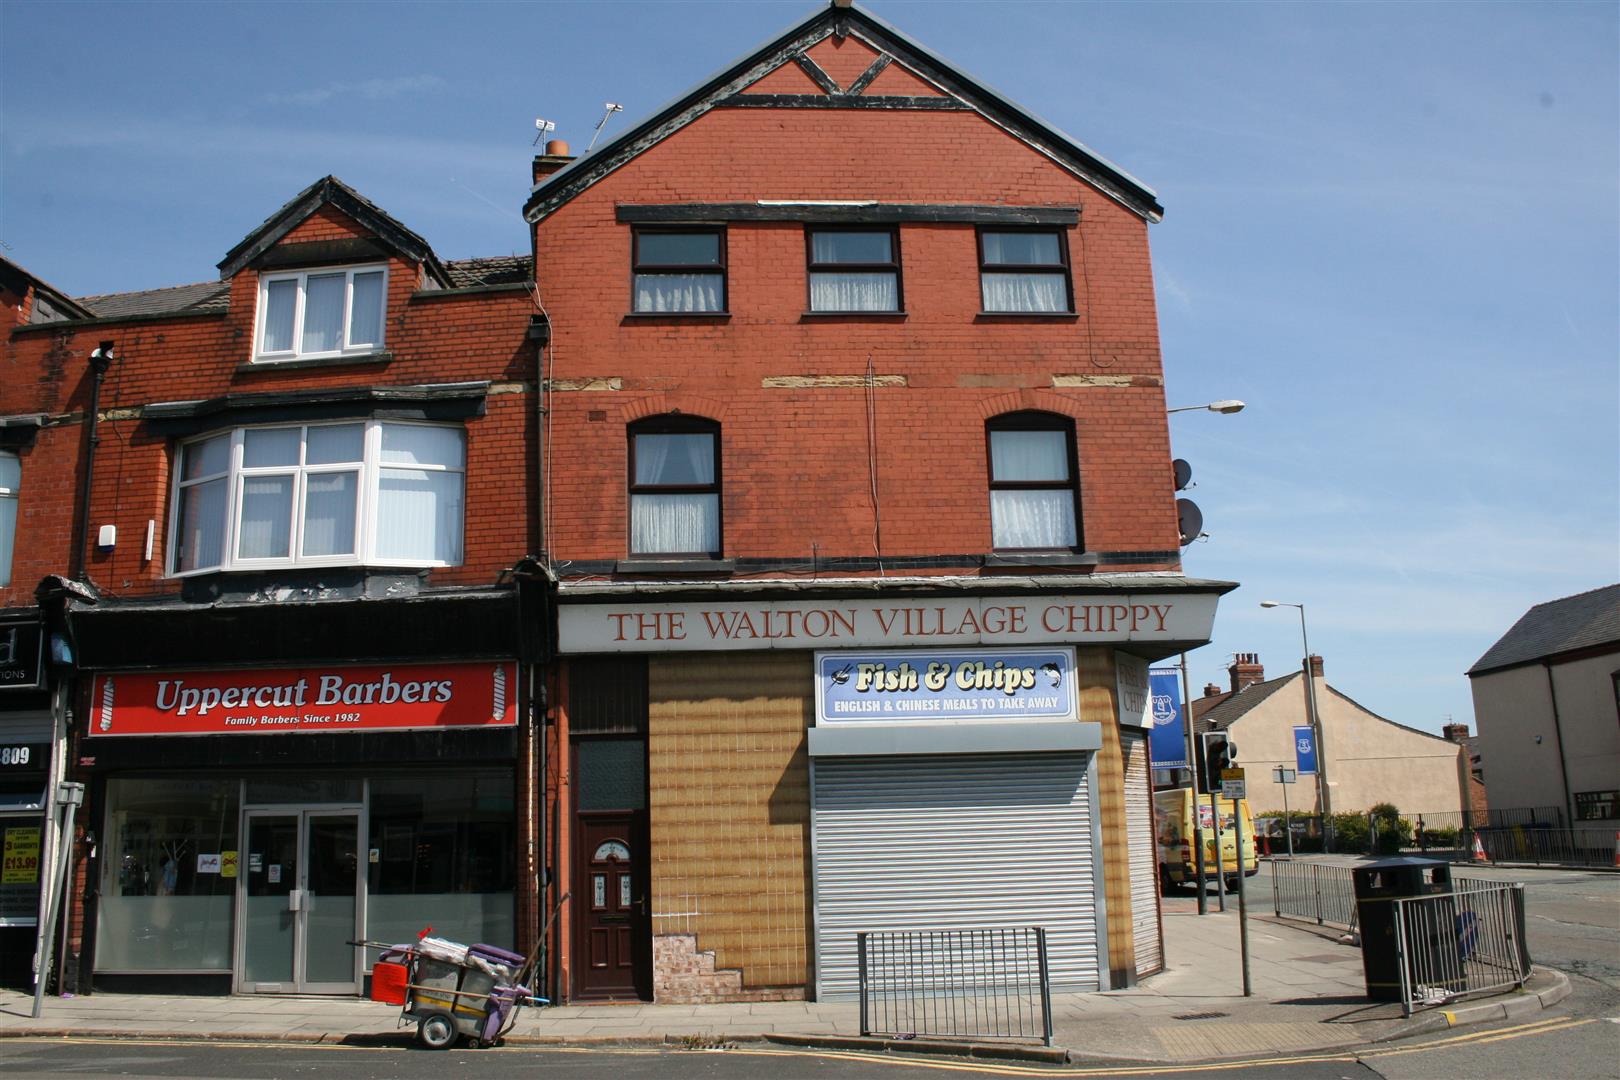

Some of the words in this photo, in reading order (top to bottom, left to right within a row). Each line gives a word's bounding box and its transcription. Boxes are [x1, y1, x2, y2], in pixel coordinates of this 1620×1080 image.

[607, 611, 687, 641] THE
[700, 609, 858, 640] WALTON
[872, 606, 1028, 637] VILLAGE
[1041, 604, 1173, 633] CHIPPY
[0, 670, 25, 680] IONS
[856, 662, 919, 693] Fish
[924, 661, 951, 692] &
[955, 660, 1036, 696] Chips
[155, 678, 309, 716] Uppercut
[315, 672, 453, 706] Barbers
[834, 700, 881, 713] ENGLISH
[883, 700, 893, 712] &
[896, 699, 940, 712] CHINESE
[943, 698, 979, 711] MEALS
[980, 698, 995, 710] TO
[998, 698, 1025, 709] TAKE
[1028, 696, 1059, 708] AWAY
[225, 716, 257, 727] Family
[260, 715, 299, 725] Barbers
[303, 714, 331, 723] Since
[334, 713, 361, 723] 1982
[0, 746, 30, 765] 809
[6, 841, 12, 851] 3
